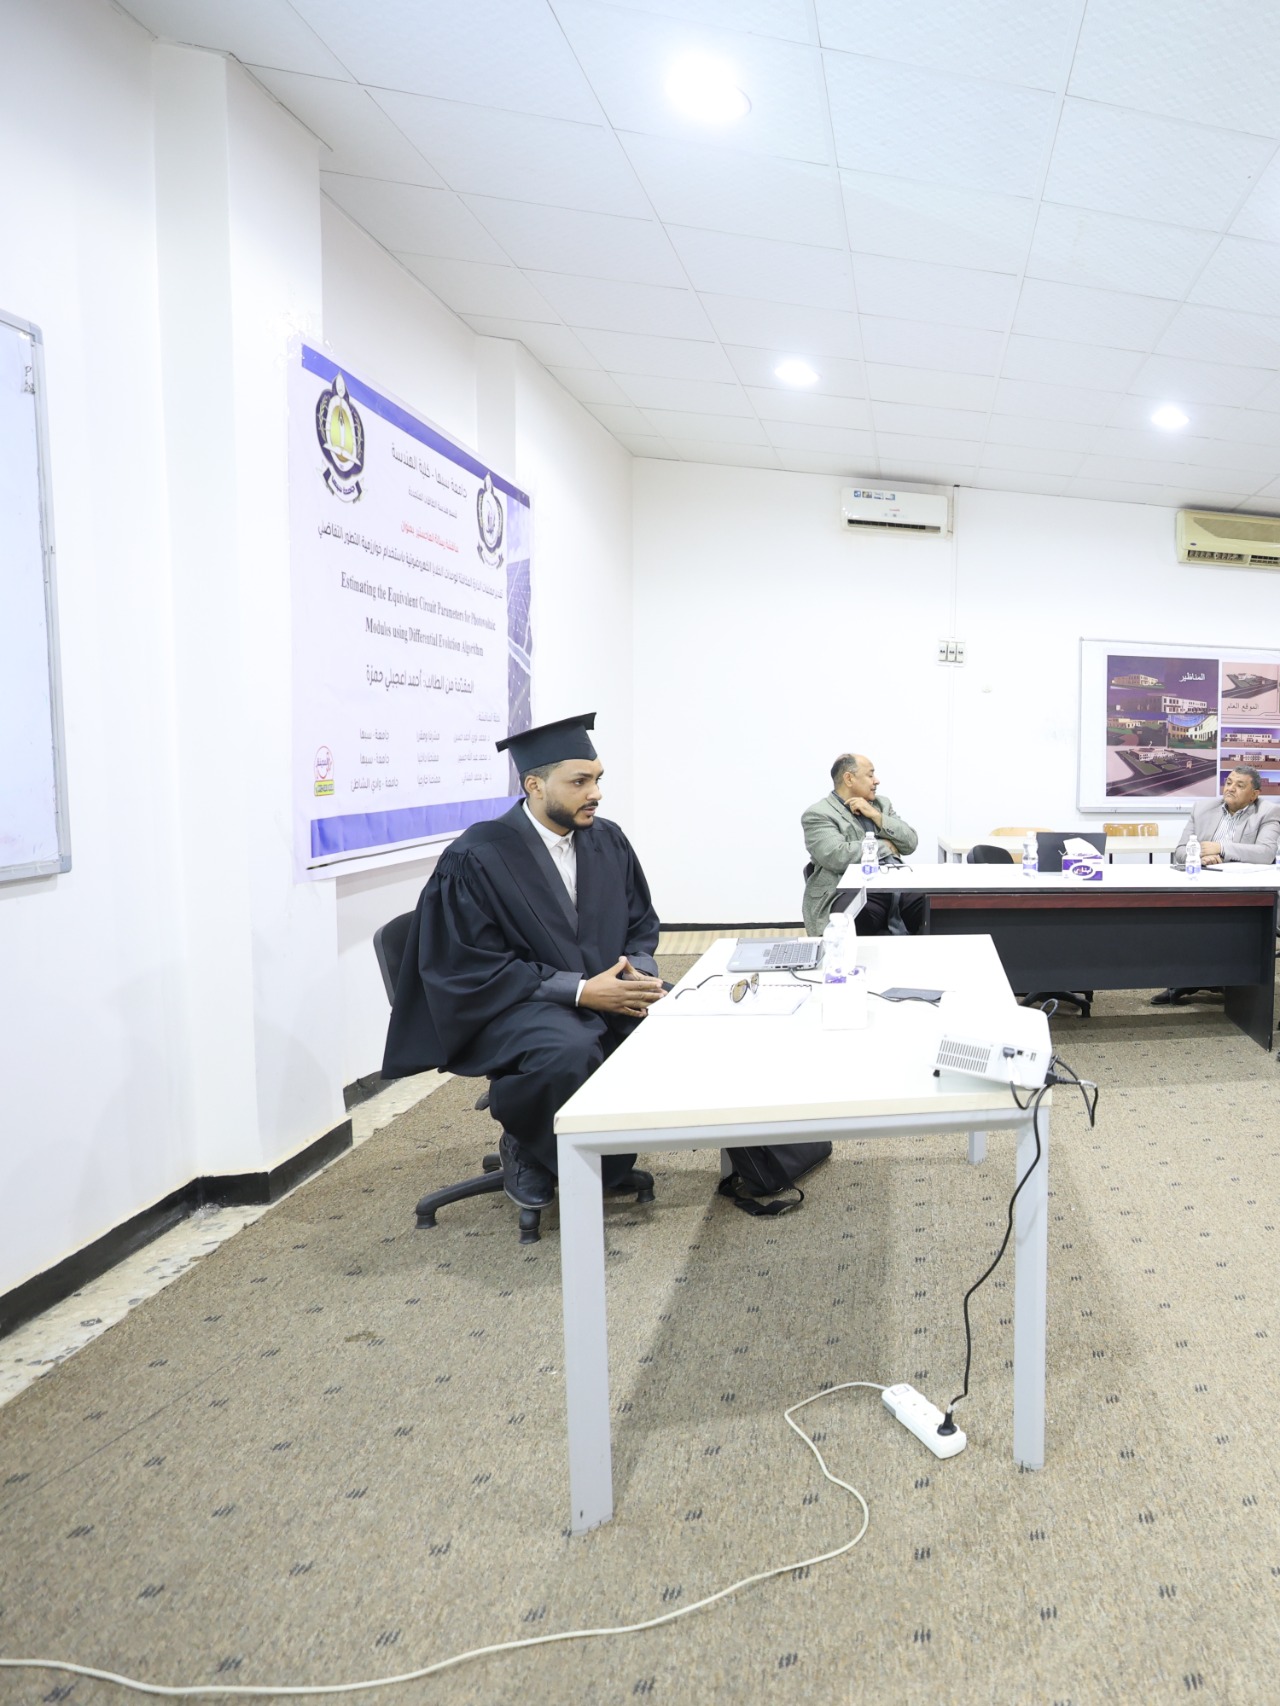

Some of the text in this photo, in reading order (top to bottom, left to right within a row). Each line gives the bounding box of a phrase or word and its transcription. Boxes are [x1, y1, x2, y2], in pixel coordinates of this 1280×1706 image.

[391, 442, 418, 470] الهندسة
[419, 458, 430, 479] كلية
[434, 467, 450, 490] سبها
[451, 477, 468, 501] جامعة
[317, 519, 344, 539] التفاضلي
[344, 530, 361, 547] التطور
[361, 535, 382, 557] خوارزمية
[383, 545, 405, 563] باستخدام
[340, 571, 376, 601] Estimating
[377, 584, 387, 601] the
[387, 586, 419, 608] Equivalent
[419, 596, 437, 614] Circuit
[437, 601, 464, 622] Parameters
[471, 611, 496, 631] Photovoltaic
[365, 616, 484, 657] Modules using Differential Evolution Algorithm
[366, 664, 384, 686] حمزة
[408, 669, 422, 688] أحمد
[1178, 671, 1206, 683] المناظير
[359, 728, 372, 742] سبها
[374, 728, 389, 742] جامعة
[359, 752, 373, 766] سبها
[375, 752, 389, 766] جامعة
[385, 776, 398, 789] جامعة
